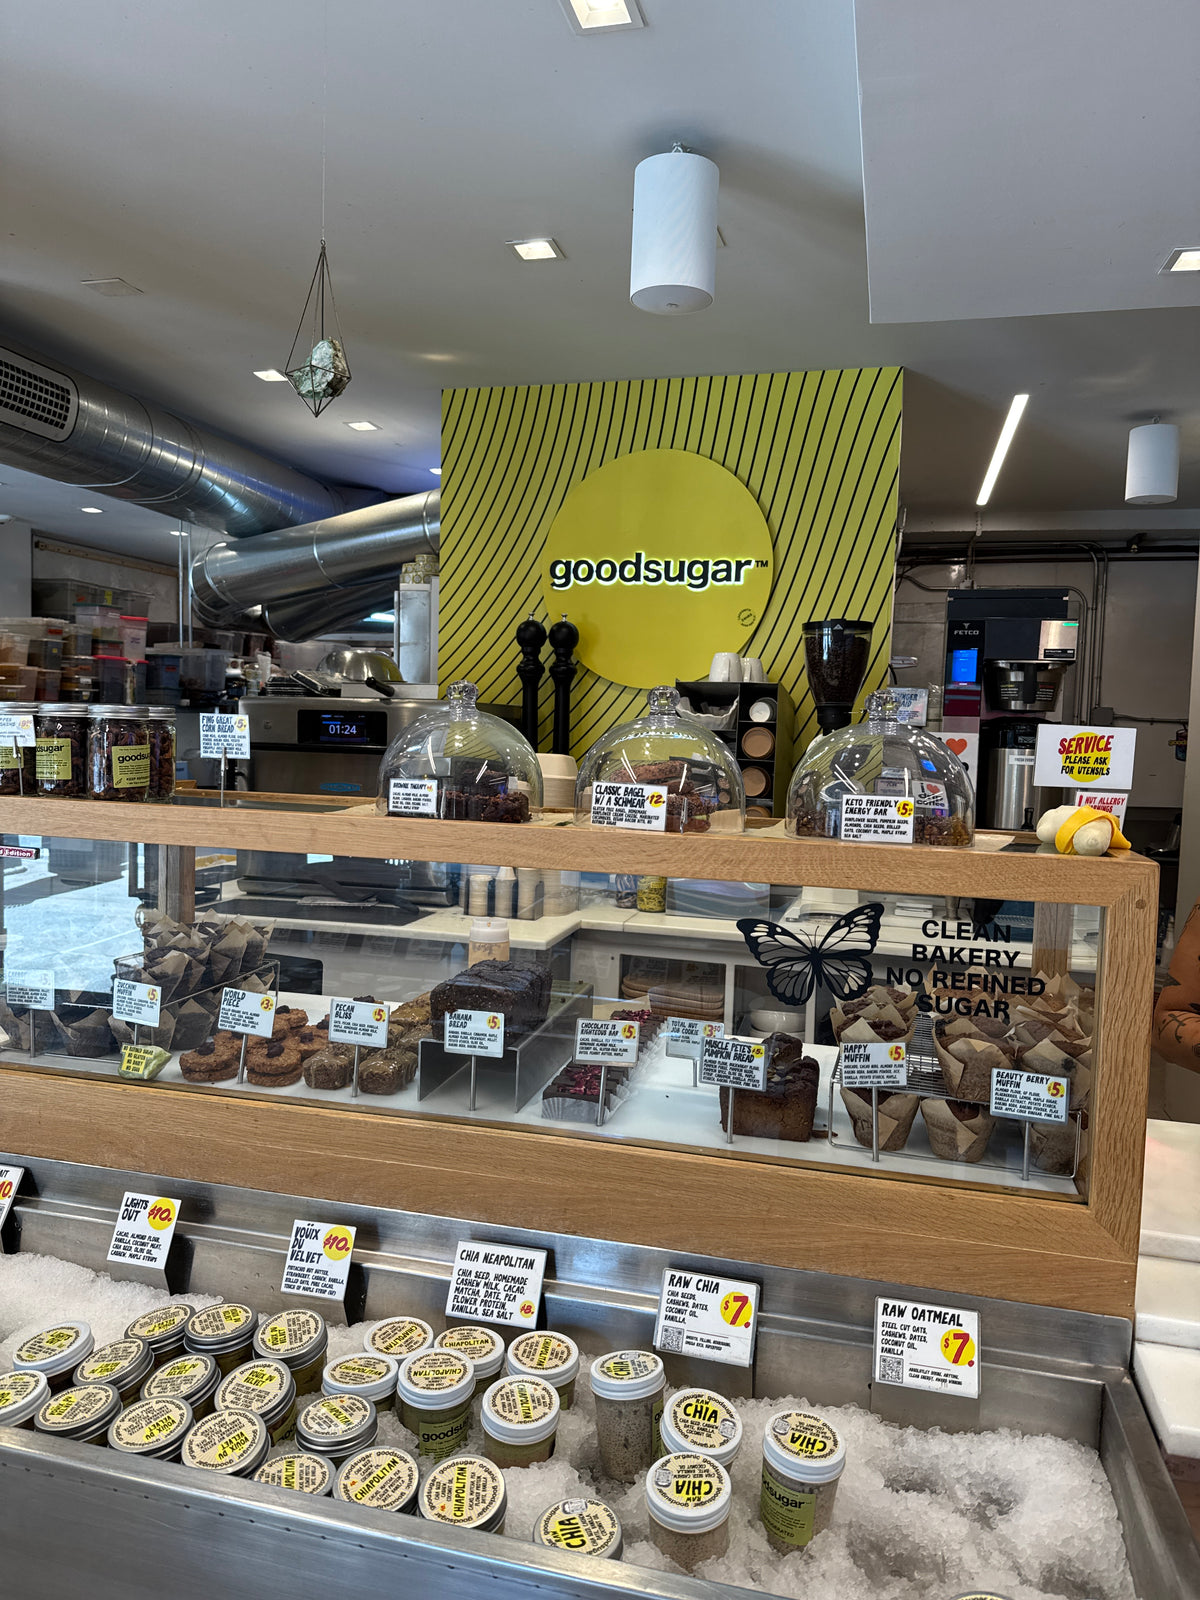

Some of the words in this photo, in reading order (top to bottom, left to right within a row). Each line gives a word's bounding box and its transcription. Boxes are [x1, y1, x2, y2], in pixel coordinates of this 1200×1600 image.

[550, 552, 753, 589] goodsugar
[218, 725, 234, 733] BREAD
[329, 725, 356, 734] 01:24
[1058, 735, 1114, 755] SERVICE
[1064, 756, 1091, 764] PLEASE
[1093, 757, 1108, 765] ASK
[1061, 766, 1074, 774] FOR
[1077, 767, 1110, 776] UTENSILS
[595, 785, 621, 795] CLASSIC
[624, 787, 645, 797] BAGEL
[614, 797, 645, 808] SCHMEAR
[866, 799, 899, 807] FRIENDLY
[1098, 797, 1125, 805] ALLERGY
[874, 808, 888, 816] BAR
[922, 920, 1011, 943] CLEAN
[912, 943, 1020, 968] BAKERY
[886, 967, 924, 986] NO
[932, 970, 1045, 996] REFINED
[224, 989, 246, 1000] WORLD
[223, 998, 240, 1007] PIECE
[335, 1003, 355, 1012] PECAN
[918, 994, 1010, 1018] SUGAR
[335, 1011, 352, 1019] BLISS
[449, 1013, 472, 1021] BANANA
[671, 1020, 686, 1028] TOTAL
[704, 1039, 729, 1050] MUSCLE
[844, 1044, 868, 1053] HAPPY
[704, 1048, 731, 1060] PUMPKIN
[733, 1052, 754, 1063] BREAD
[844, 1054, 870, 1062] MUFFIN
[996, 1071, 1023, 1080] BEAUTY
[1026, 1075, 1050, 1085] BERRY
[996, 1079, 1021, 1089] MUFFIN
[124, 1197, 149, 1210] LIGHTS
[122, 1208, 141, 1222] OUT
[292, 1238, 305, 1249] DU
[290, 1250, 323, 1264] VELVET
[460, 1250, 480, 1262] CHIA
[482, 1253, 535, 1270] NEAPOLITAN
[458, 1268, 472, 1277] CHIA
[474, 1271, 490, 1280] SEED,
[494, 1274, 528, 1285] HOMEMADE
[456, 1277, 482, 1288] CASHEW
[483, 1282, 500, 1291] MILK,
[503, 1284, 525, 1295] CACAO,
[668, 1274, 693, 1289] RAW
[695, 1279, 720, 1294] CHIA
[454, 1286, 480, 1298] MATCHA,
[484, 1290, 501, 1300] DATE,
[504, 1293, 516, 1303] PEA
[680, 1292, 697, 1301] SEEDS,
[453, 1295, 478, 1306] FLOWER
[479, 1299, 507, 1310] PROTEIN,
[666, 1298, 690, 1308] CASHEWS,
[692, 1302, 709, 1311] DATES,
[451, 1304, 479, 1316] VANILLA,
[482, 1308, 494, 1317] SEA
[496, 1311, 513, 1320] SALT
[665, 1306, 687, 1316] COCONUT
[689, 1310, 698, 1318] OIL,
[882, 1303, 907, 1318] RAW
[911, 1307, 963, 1327] OATMEAL
[881, 1321, 898, 1329] STEEL
[913, 1326, 927, 1334] OATS,
[881, 1329, 907, 1340] CASHEWS,
[909, 1333, 928, 1343] DATES,
[444, 1339, 489, 1348] CHIAPOLITAN
[881, 1338, 905, 1347] COCONUT
[907, 1342, 917, 1350] OIL,
[881, 1347, 904, 1356] VANILLA
[412, 1367, 462, 1377] CHIAPOLITAN
[516, 1384, 533, 1419] CHIAPOLITAN
[683, 1403, 718, 1423] CHIA
[790, 1432, 827, 1452] CHIA
[355, 1458, 399, 1501] CHIAPOLITAN
[454, 1467, 467, 1517] CHIAPOLITAN
[675, 1480, 713, 1496] CHIA
[558, 1517, 587, 1548] CHIA
